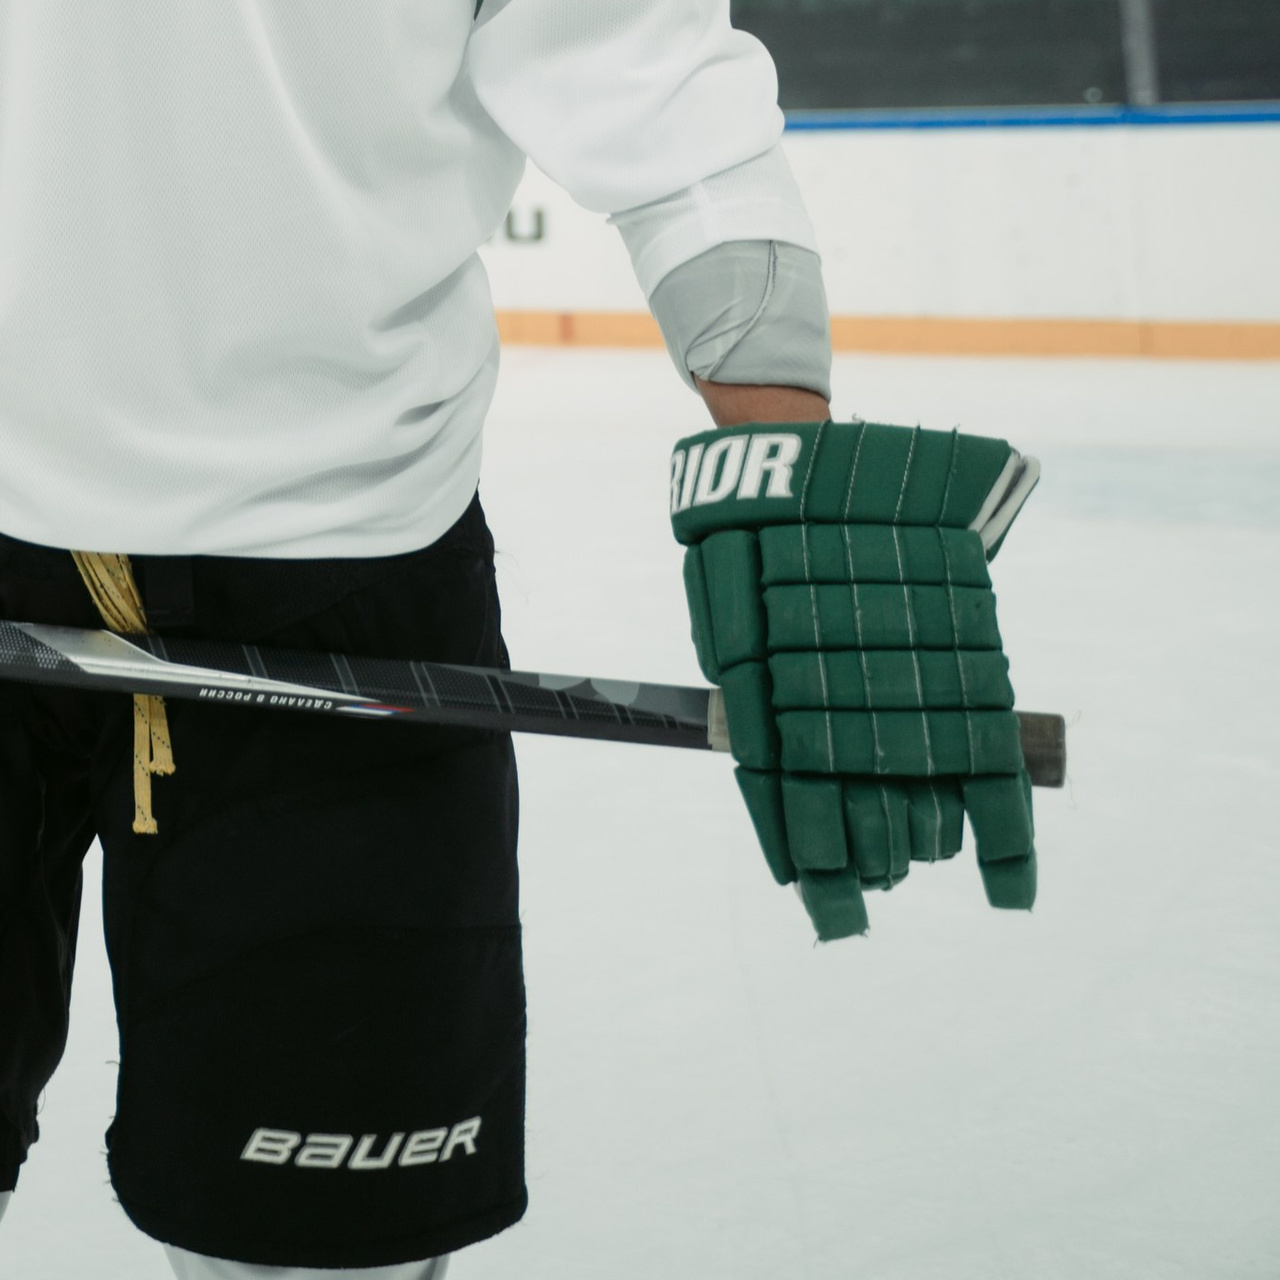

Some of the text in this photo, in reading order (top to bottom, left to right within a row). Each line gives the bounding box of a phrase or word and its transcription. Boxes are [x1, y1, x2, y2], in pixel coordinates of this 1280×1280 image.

[199, 688, 333, 710] СДЕЛАНО В РОССИИ
[239, 1115, 482, 1170] BAUER
